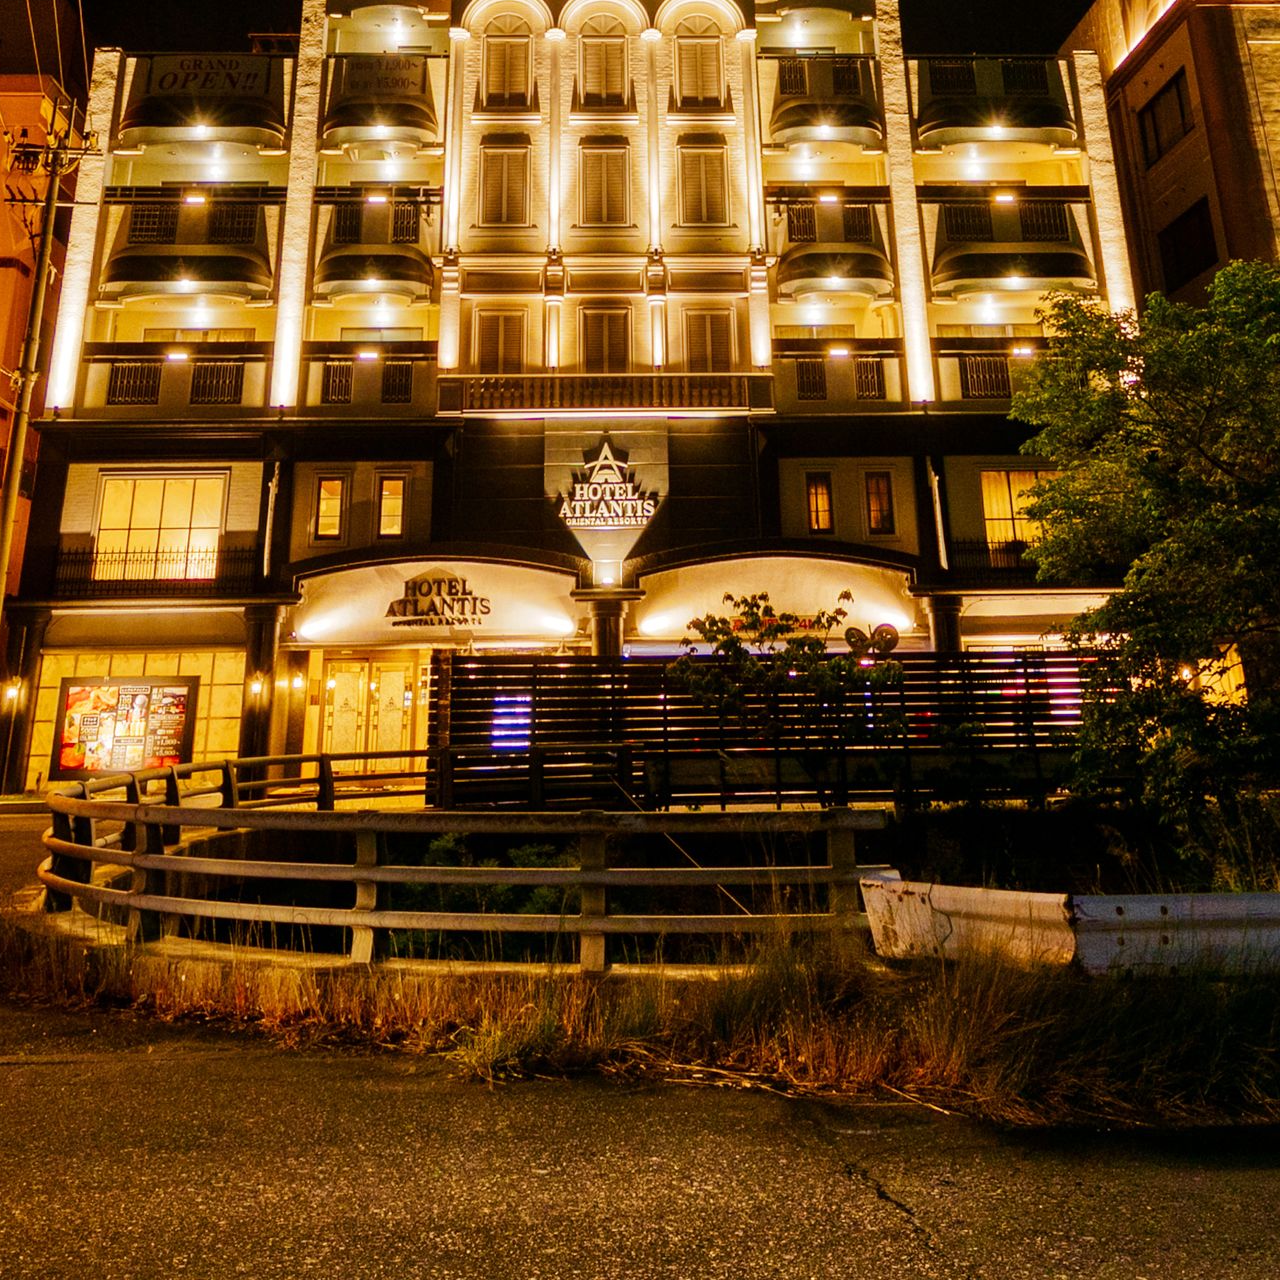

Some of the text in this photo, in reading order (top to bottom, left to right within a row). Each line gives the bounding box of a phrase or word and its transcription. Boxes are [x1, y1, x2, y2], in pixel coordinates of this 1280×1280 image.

[180, 59, 239, 71] GRAND
[159, 72, 258, 90] OPEN!!
[574, 482, 639, 500] HOTEL
[558, 500, 656, 518] ATLANTIS
[565, 517, 648, 526] ORIENTAL RESORTS
[403, 577, 474, 598] HOTEL
[385, 596, 492, 618] ATLANTIS
